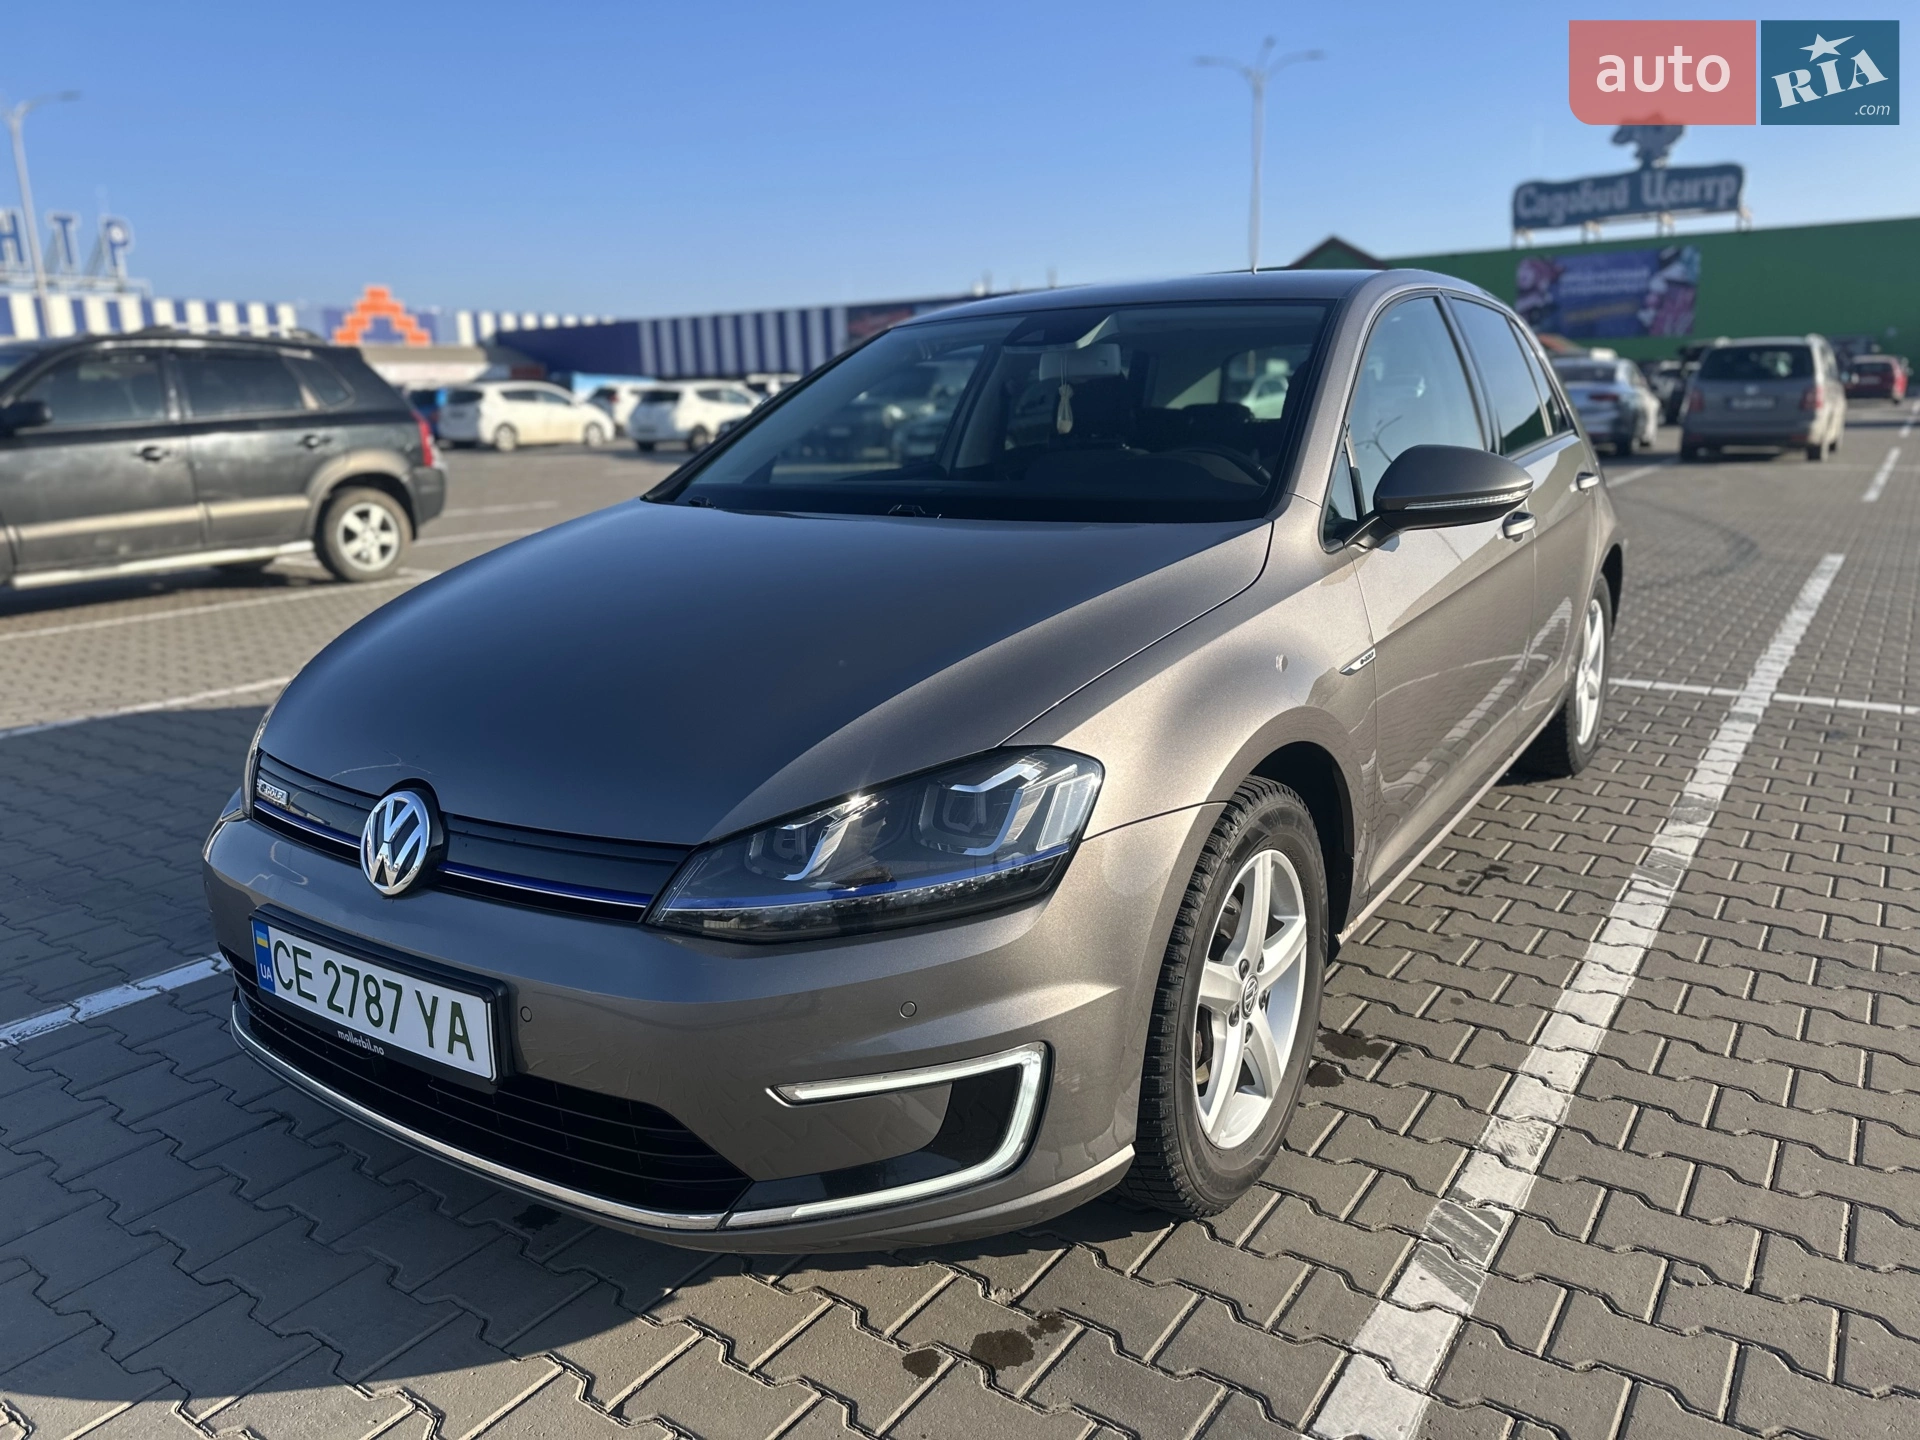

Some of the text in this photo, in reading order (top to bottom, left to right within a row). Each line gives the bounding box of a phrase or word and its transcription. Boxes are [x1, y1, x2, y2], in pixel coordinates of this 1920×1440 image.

[259, 962, 273, 982] UA
[273, 939, 475, 1062] CE 2787 YA
